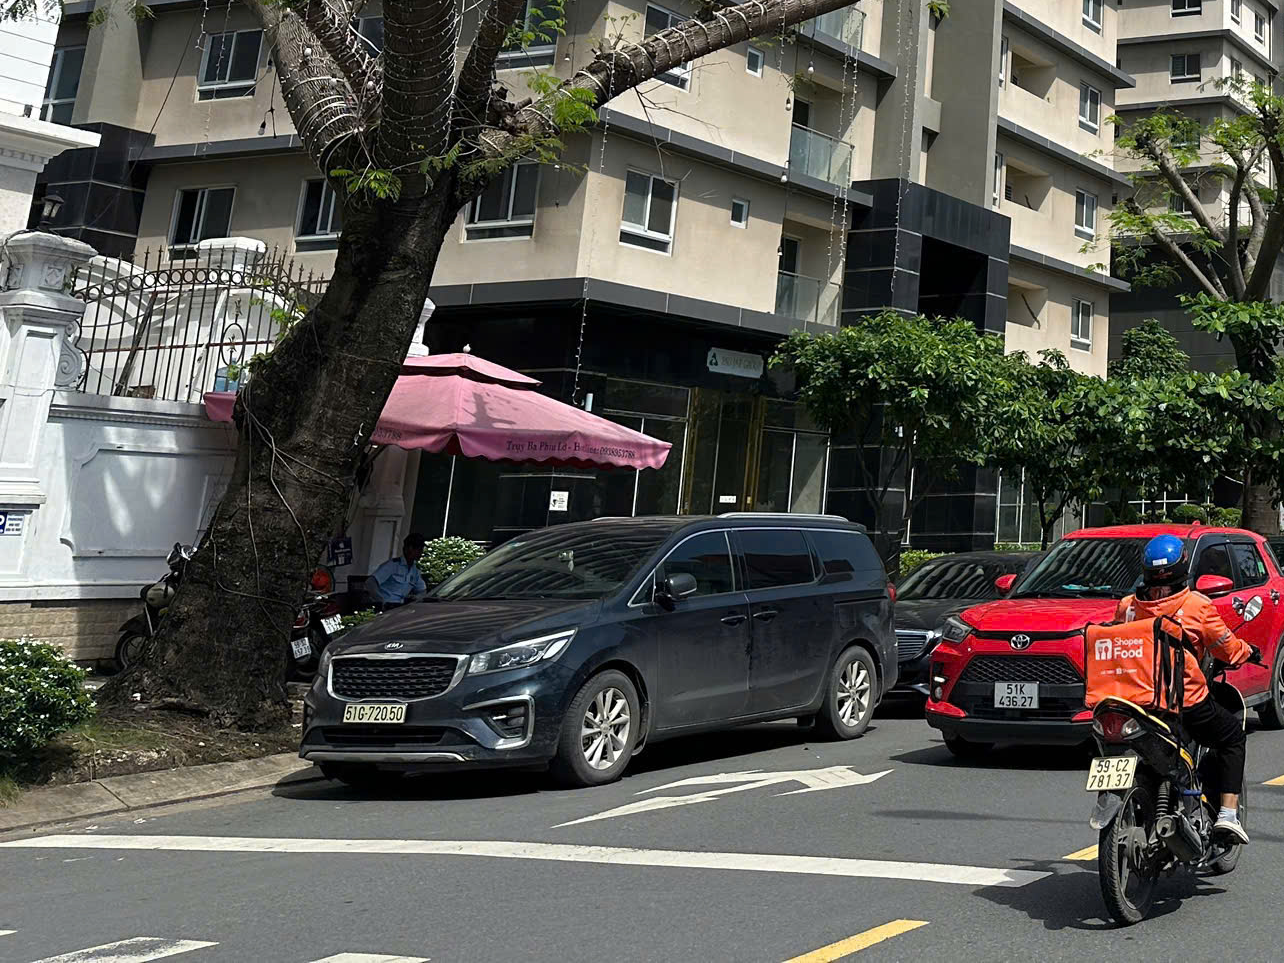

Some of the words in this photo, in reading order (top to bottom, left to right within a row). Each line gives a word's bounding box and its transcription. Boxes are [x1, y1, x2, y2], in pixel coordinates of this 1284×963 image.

[1113, 637, 1144, 647] Shopee
[1113, 646, 1143, 659] Food
[1006, 683, 1025, 695] 51K
[999, 696, 1034, 707] 436.27
[345, 706, 404, 721] 51G-720.50
[1096, 758, 1130, 773] 59-C2
[1089, 773, 1131, 788] 781.37
